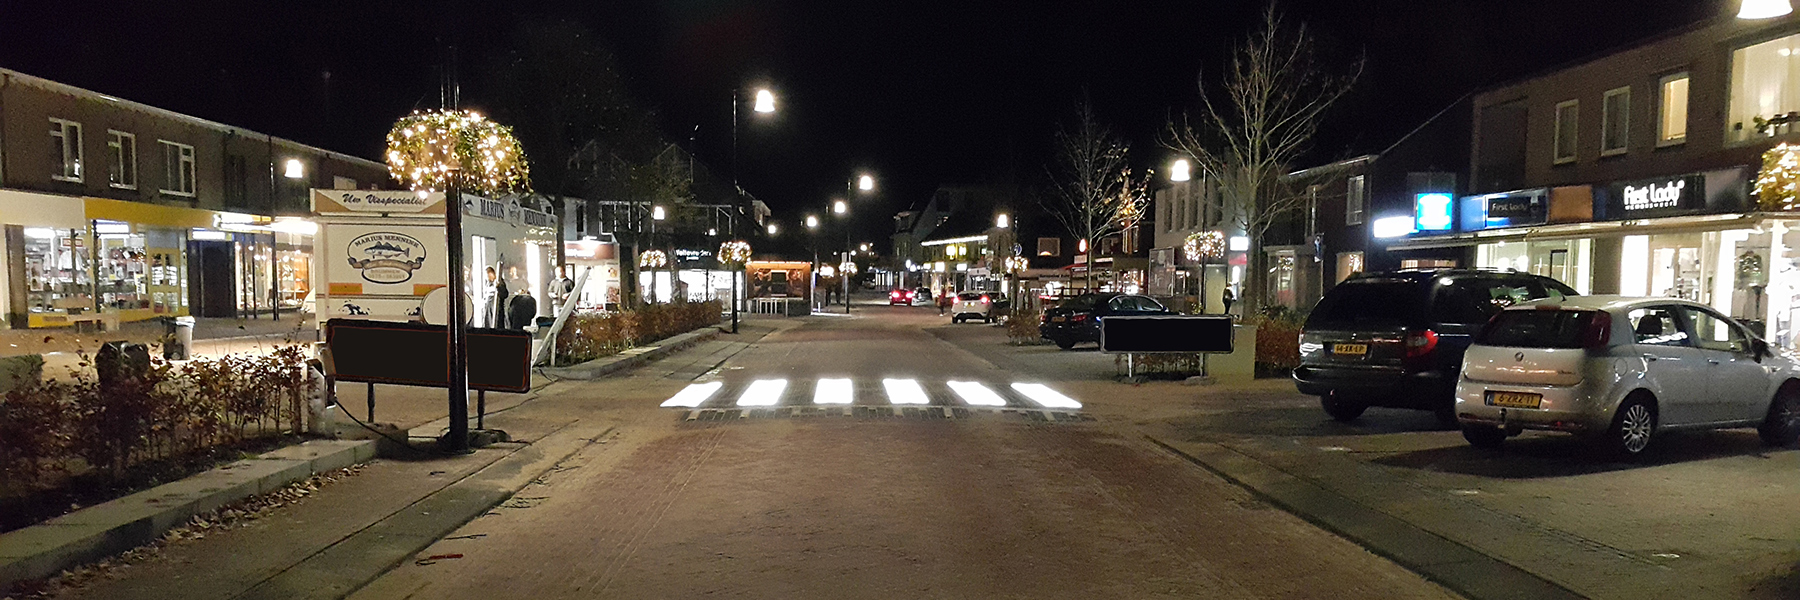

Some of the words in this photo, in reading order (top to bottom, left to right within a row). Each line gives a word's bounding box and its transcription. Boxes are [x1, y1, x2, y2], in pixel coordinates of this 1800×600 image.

[365, 194, 427, 206] Visspecialist
[480, 198, 505, 219] MARIUS
[354, 235, 383, 247] MARIUS
